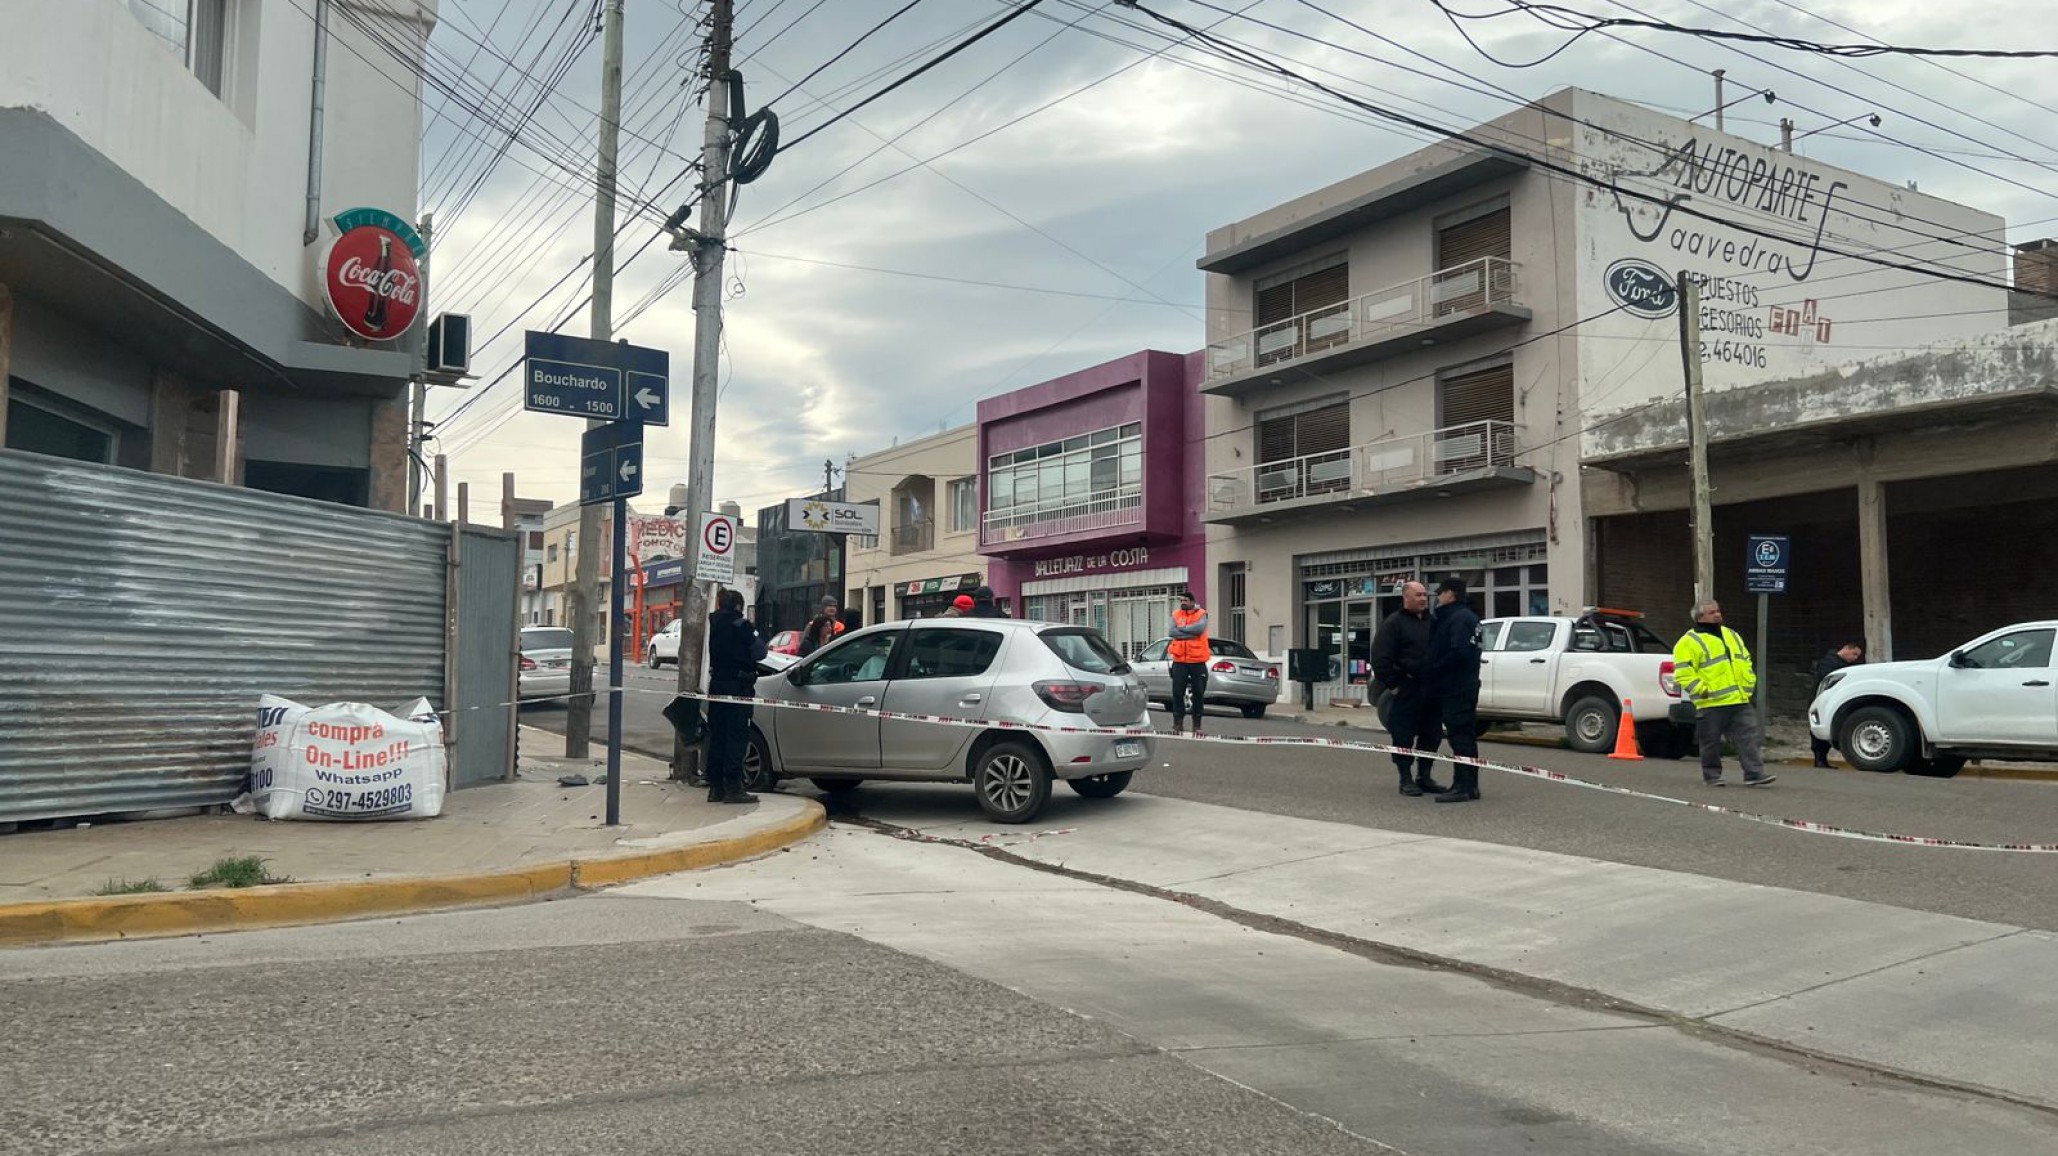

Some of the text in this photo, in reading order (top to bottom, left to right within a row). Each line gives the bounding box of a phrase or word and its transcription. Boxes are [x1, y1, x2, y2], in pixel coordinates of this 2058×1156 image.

[339, 256, 417, 305] Coca-Cola
[1620, 267, 1665, 305] Ford
[1700, 305, 1763, 340] CESORIOS
[534, 370, 607, 391] Bouchardo
[532, 394, 560, 407] 1600
[585, 400, 613, 413] 1500
[835, 509, 863, 520] SOL
[715, 526, 727, 546] E
[1110, 546, 1149, 567] COSTA
[306, 740, 409, 770] On-Line!!!
[315, 768, 402, 784] Whatsapp
[327, 783, 412, 811] 297-4529803
